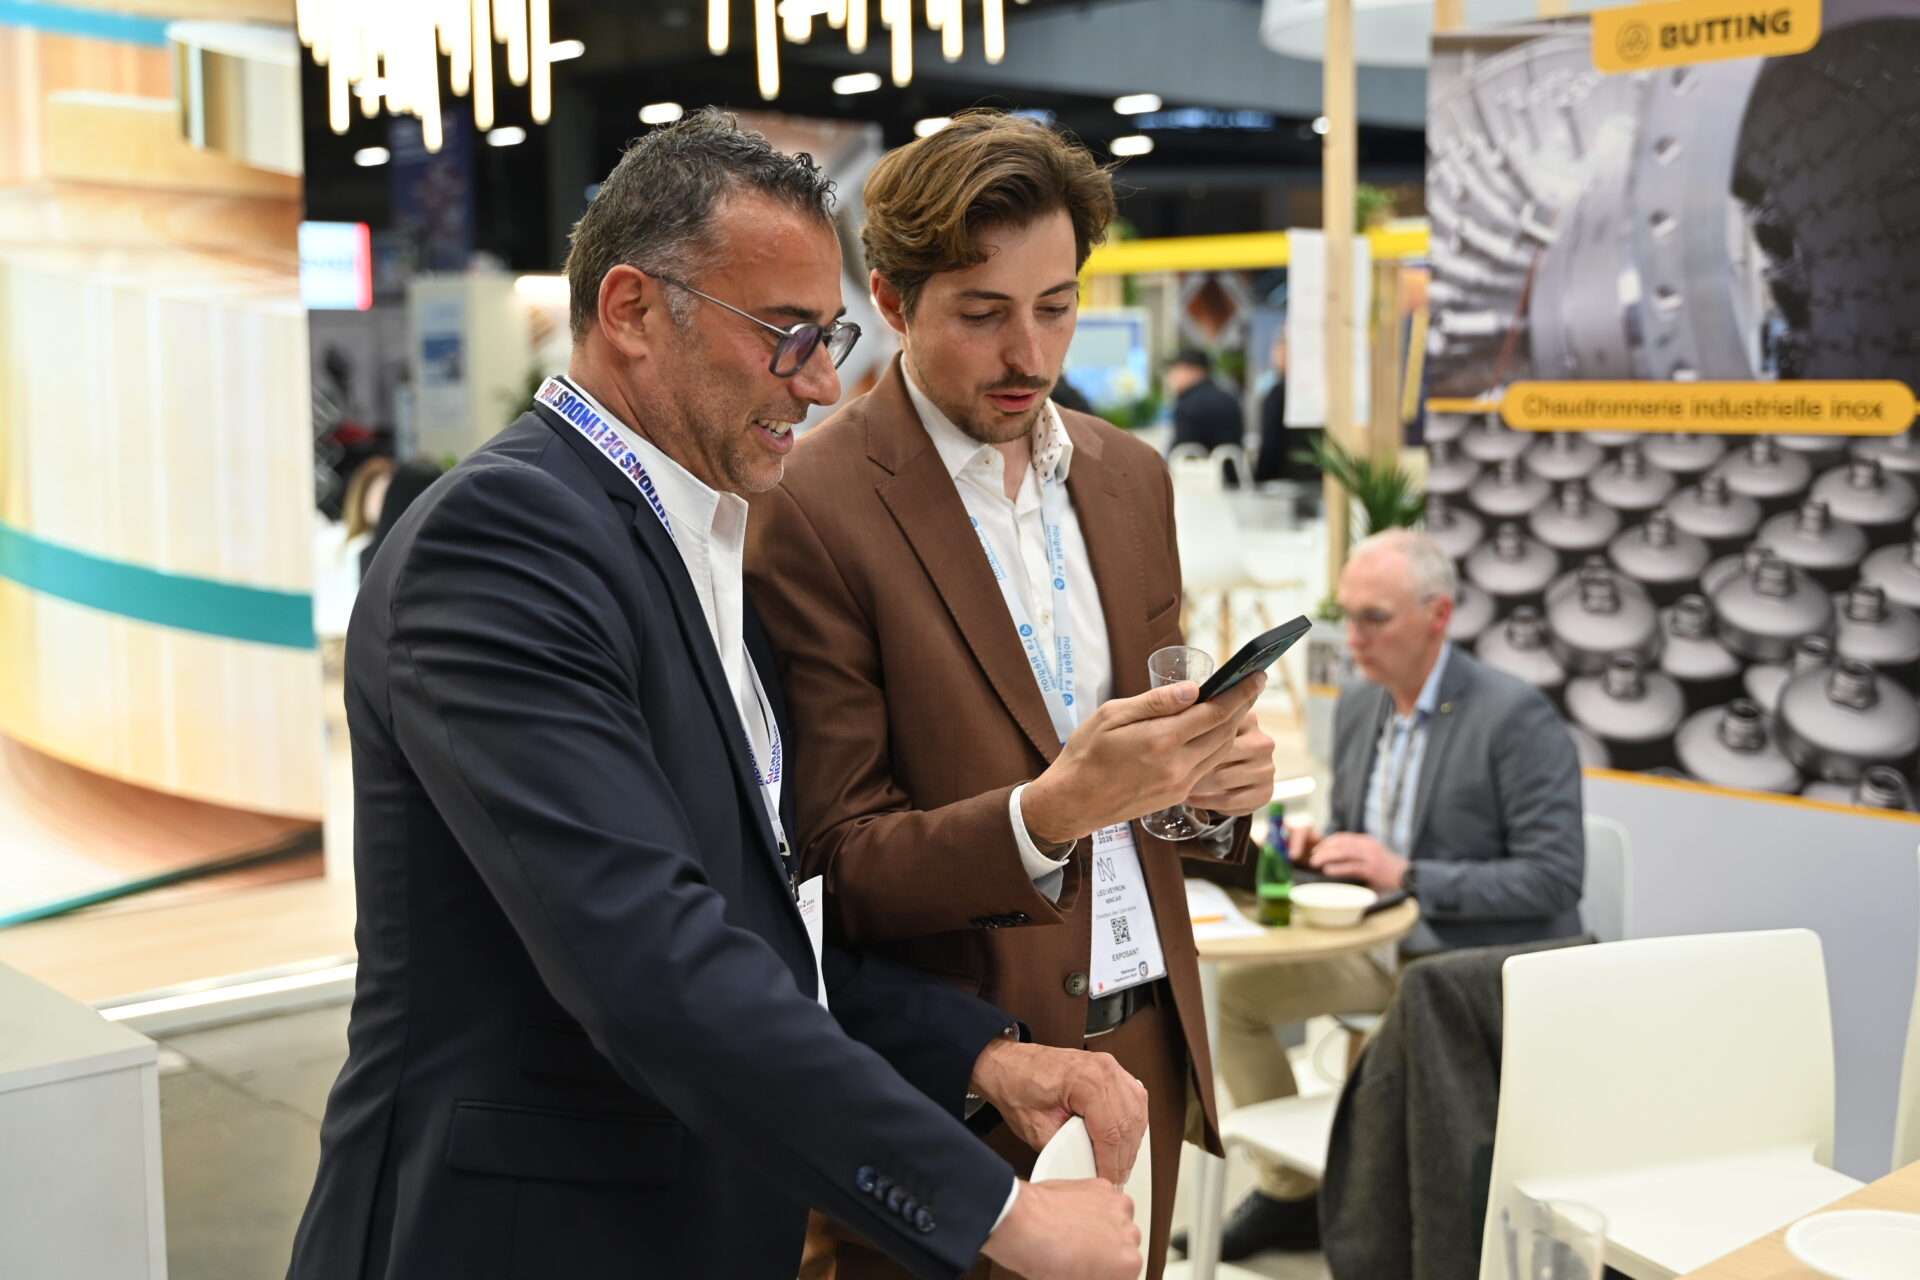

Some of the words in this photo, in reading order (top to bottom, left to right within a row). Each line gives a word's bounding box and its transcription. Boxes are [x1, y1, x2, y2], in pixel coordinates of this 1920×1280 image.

[1660, 9, 1791, 50] BUTTING
[1522, 393, 1682, 419] Chaudronnerie
[1690, 394, 1822, 419] industrielle
[1830, 394, 1884, 420] inox
[600, 431, 628, 459] DE
